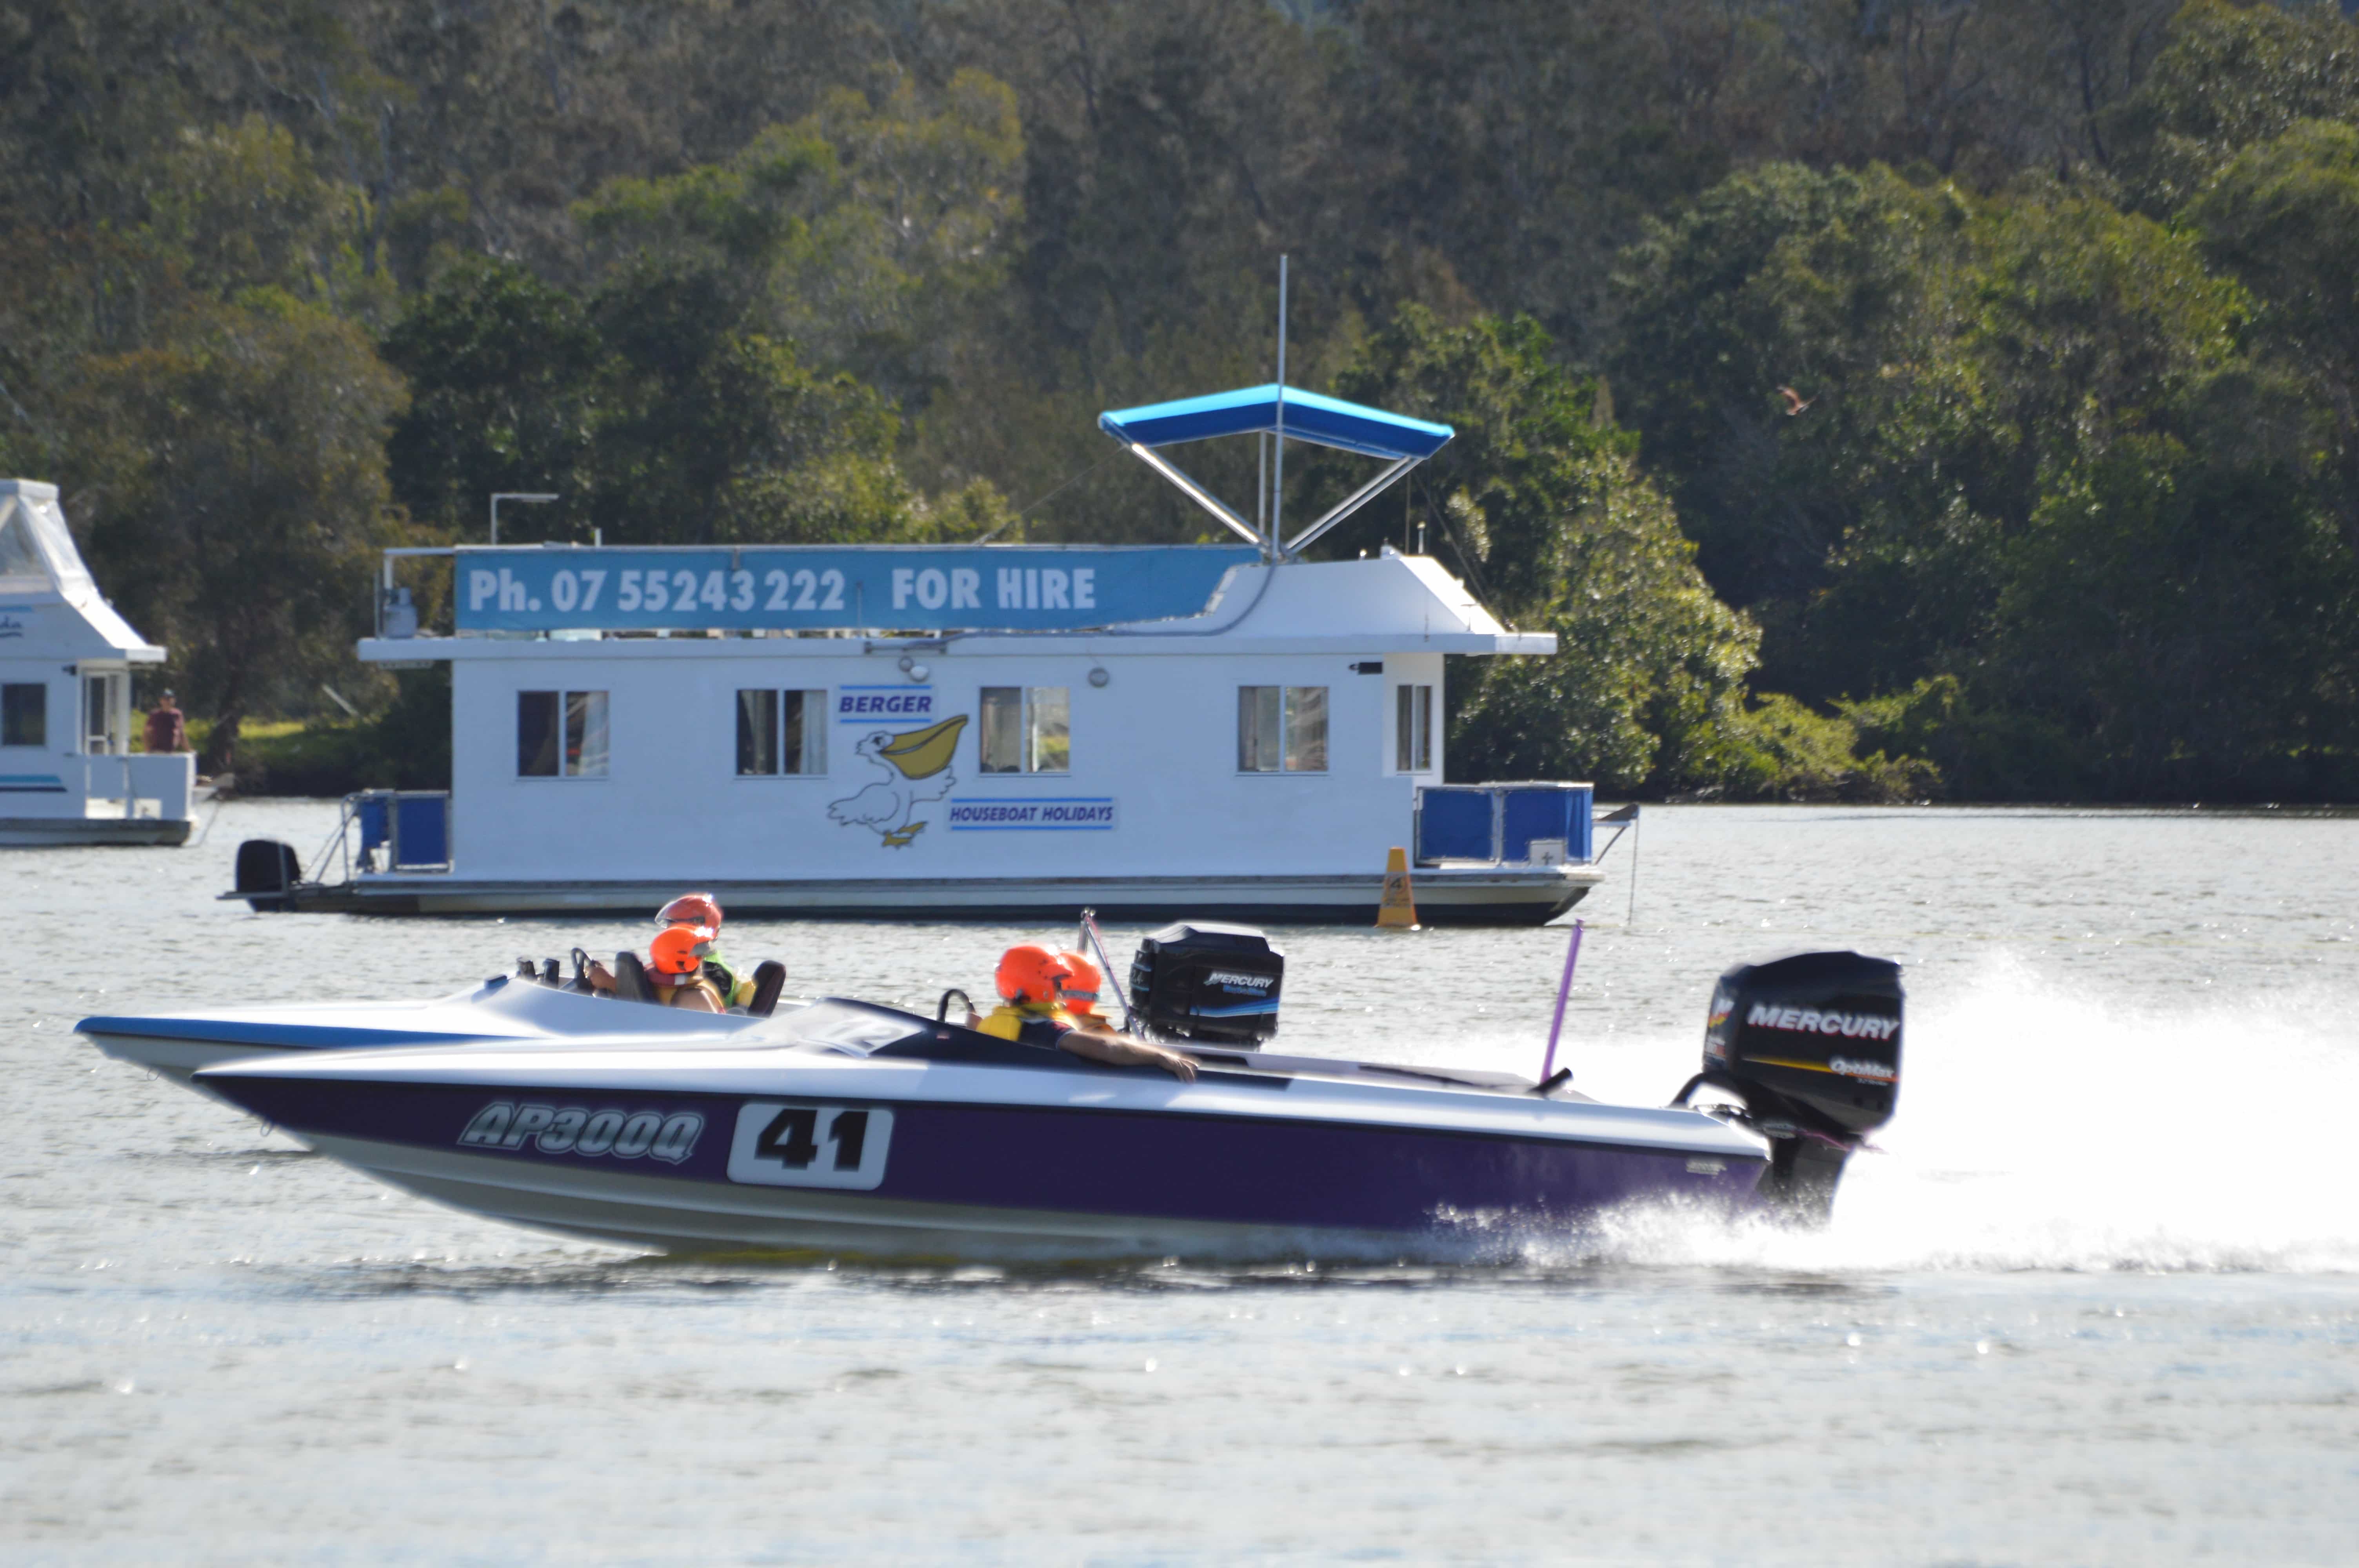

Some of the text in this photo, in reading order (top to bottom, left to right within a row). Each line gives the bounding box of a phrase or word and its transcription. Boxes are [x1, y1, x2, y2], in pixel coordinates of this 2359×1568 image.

[470, 568, 541, 611] Ph.
[552, 570, 607, 611] 07
[892, 568, 1095, 610] FOR HIRE
[839, 695, 932, 713] BERGER
[949, 806, 1113, 822] HOUSEBOAT HOLIDAYS
[1204, 973, 1274, 988] MERCURY
[1747, 1004, 1901, 1041] MERCURY
[457, 1102, 705, 1165] AP300Q
[754, 1108, 869, 1173] 41
